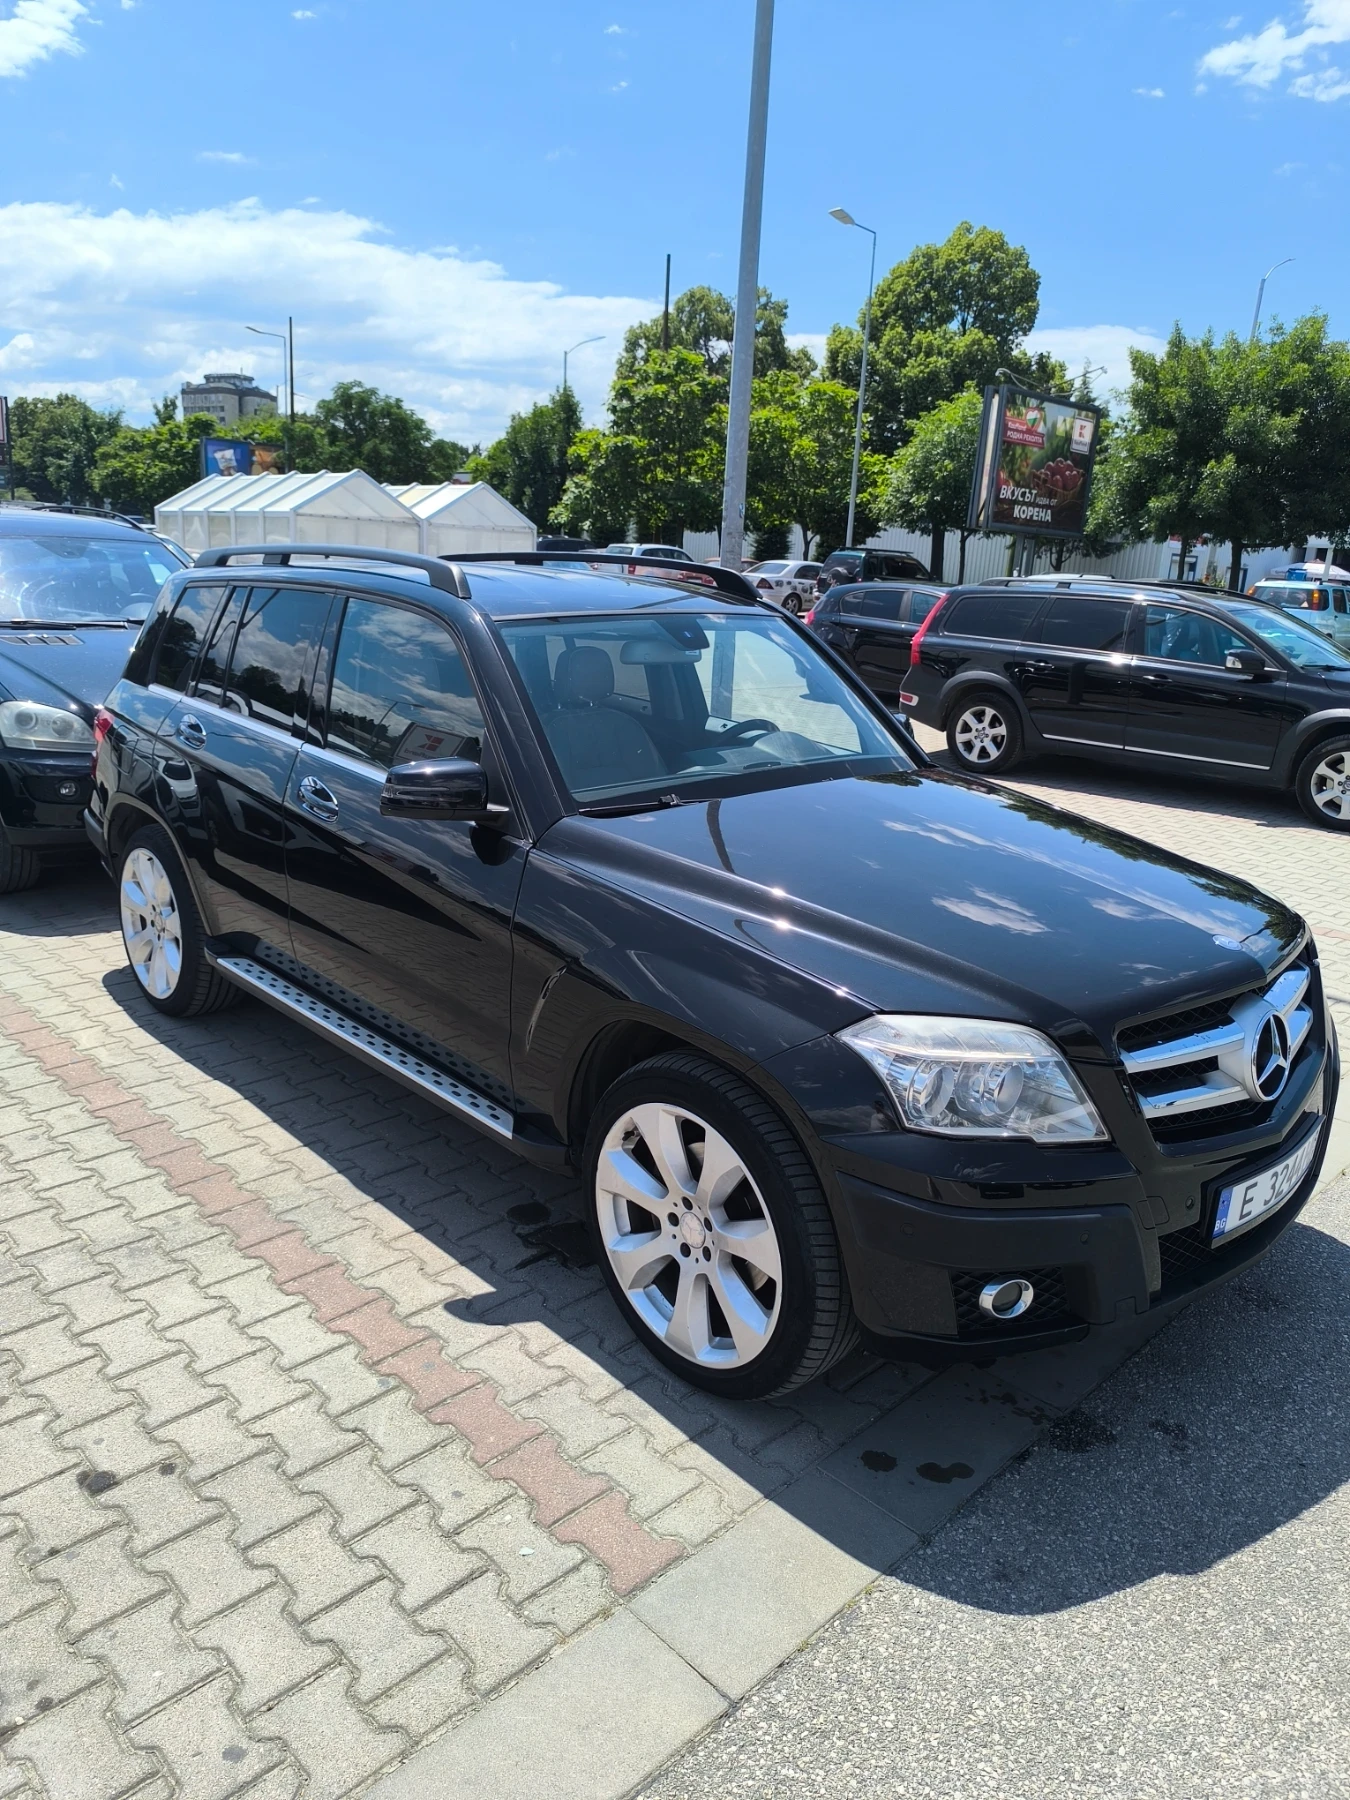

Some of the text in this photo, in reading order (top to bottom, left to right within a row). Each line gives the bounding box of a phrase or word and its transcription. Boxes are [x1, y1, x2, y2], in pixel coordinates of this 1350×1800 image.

[1007, 430, 1023, 440] РОДНА
[999, 485, 1038, 503] ВКУСЪТ
[1013, 504, 1052, 523] КОРЕНА
[1238, 1182, 1258, 1221] E
[1214, 1217, 1227, 1231] BG
